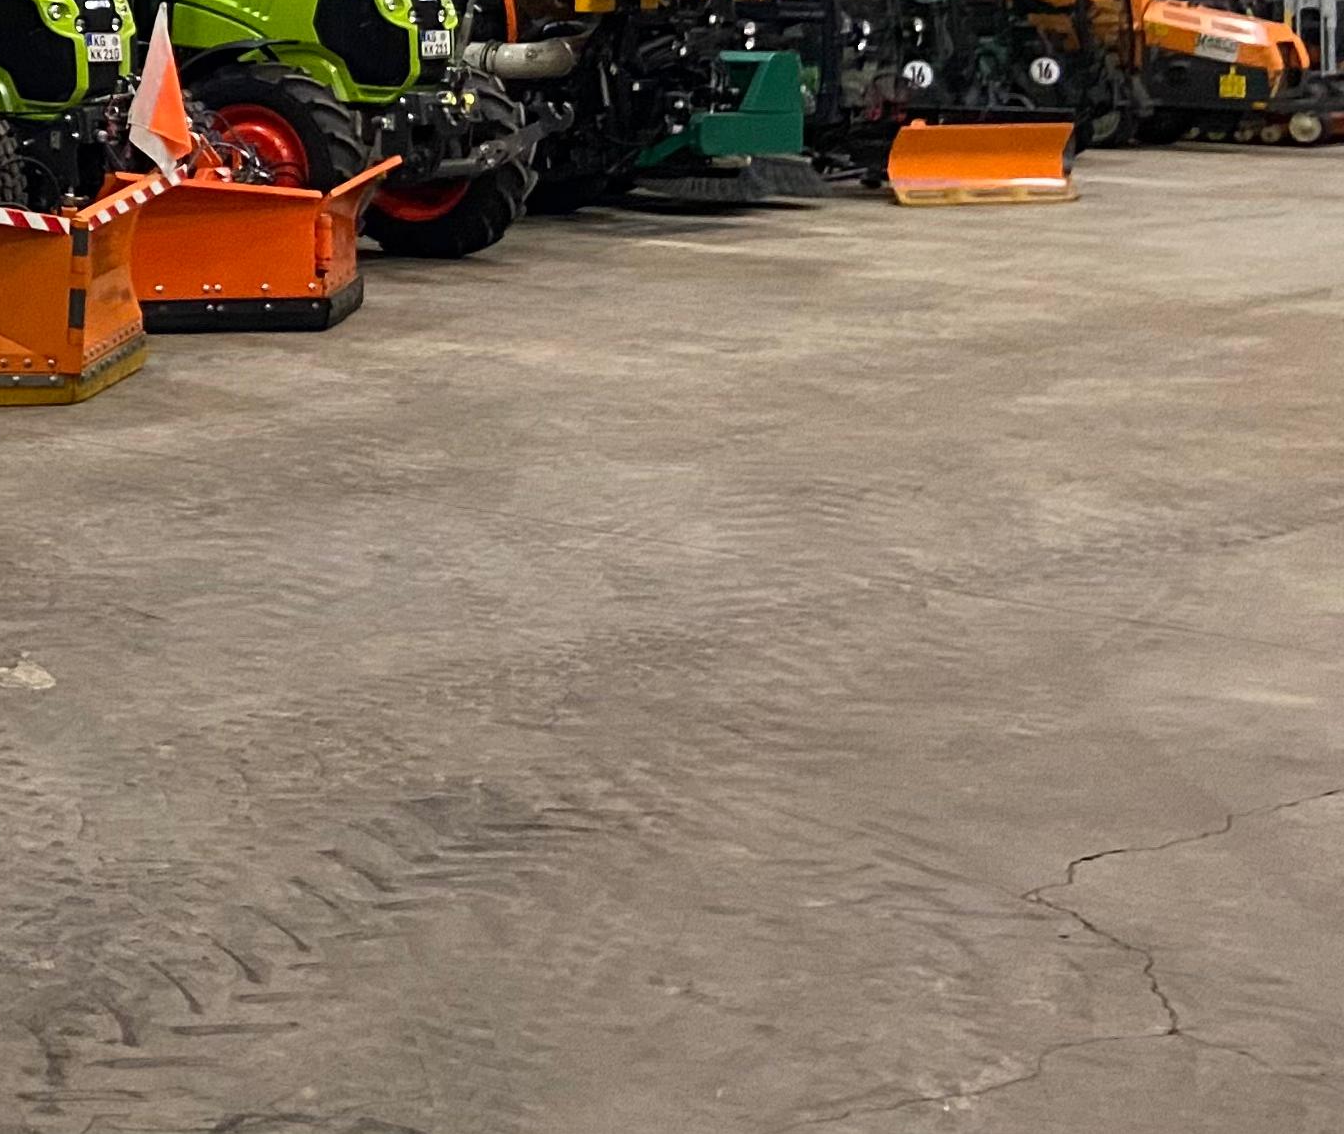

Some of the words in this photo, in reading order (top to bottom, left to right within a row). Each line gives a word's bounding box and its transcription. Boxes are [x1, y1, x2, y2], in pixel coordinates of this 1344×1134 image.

[94, 35, 106, 47] KG
[910, 65, 926, 83] 16
[1038, 62, 1053, 80] 16
